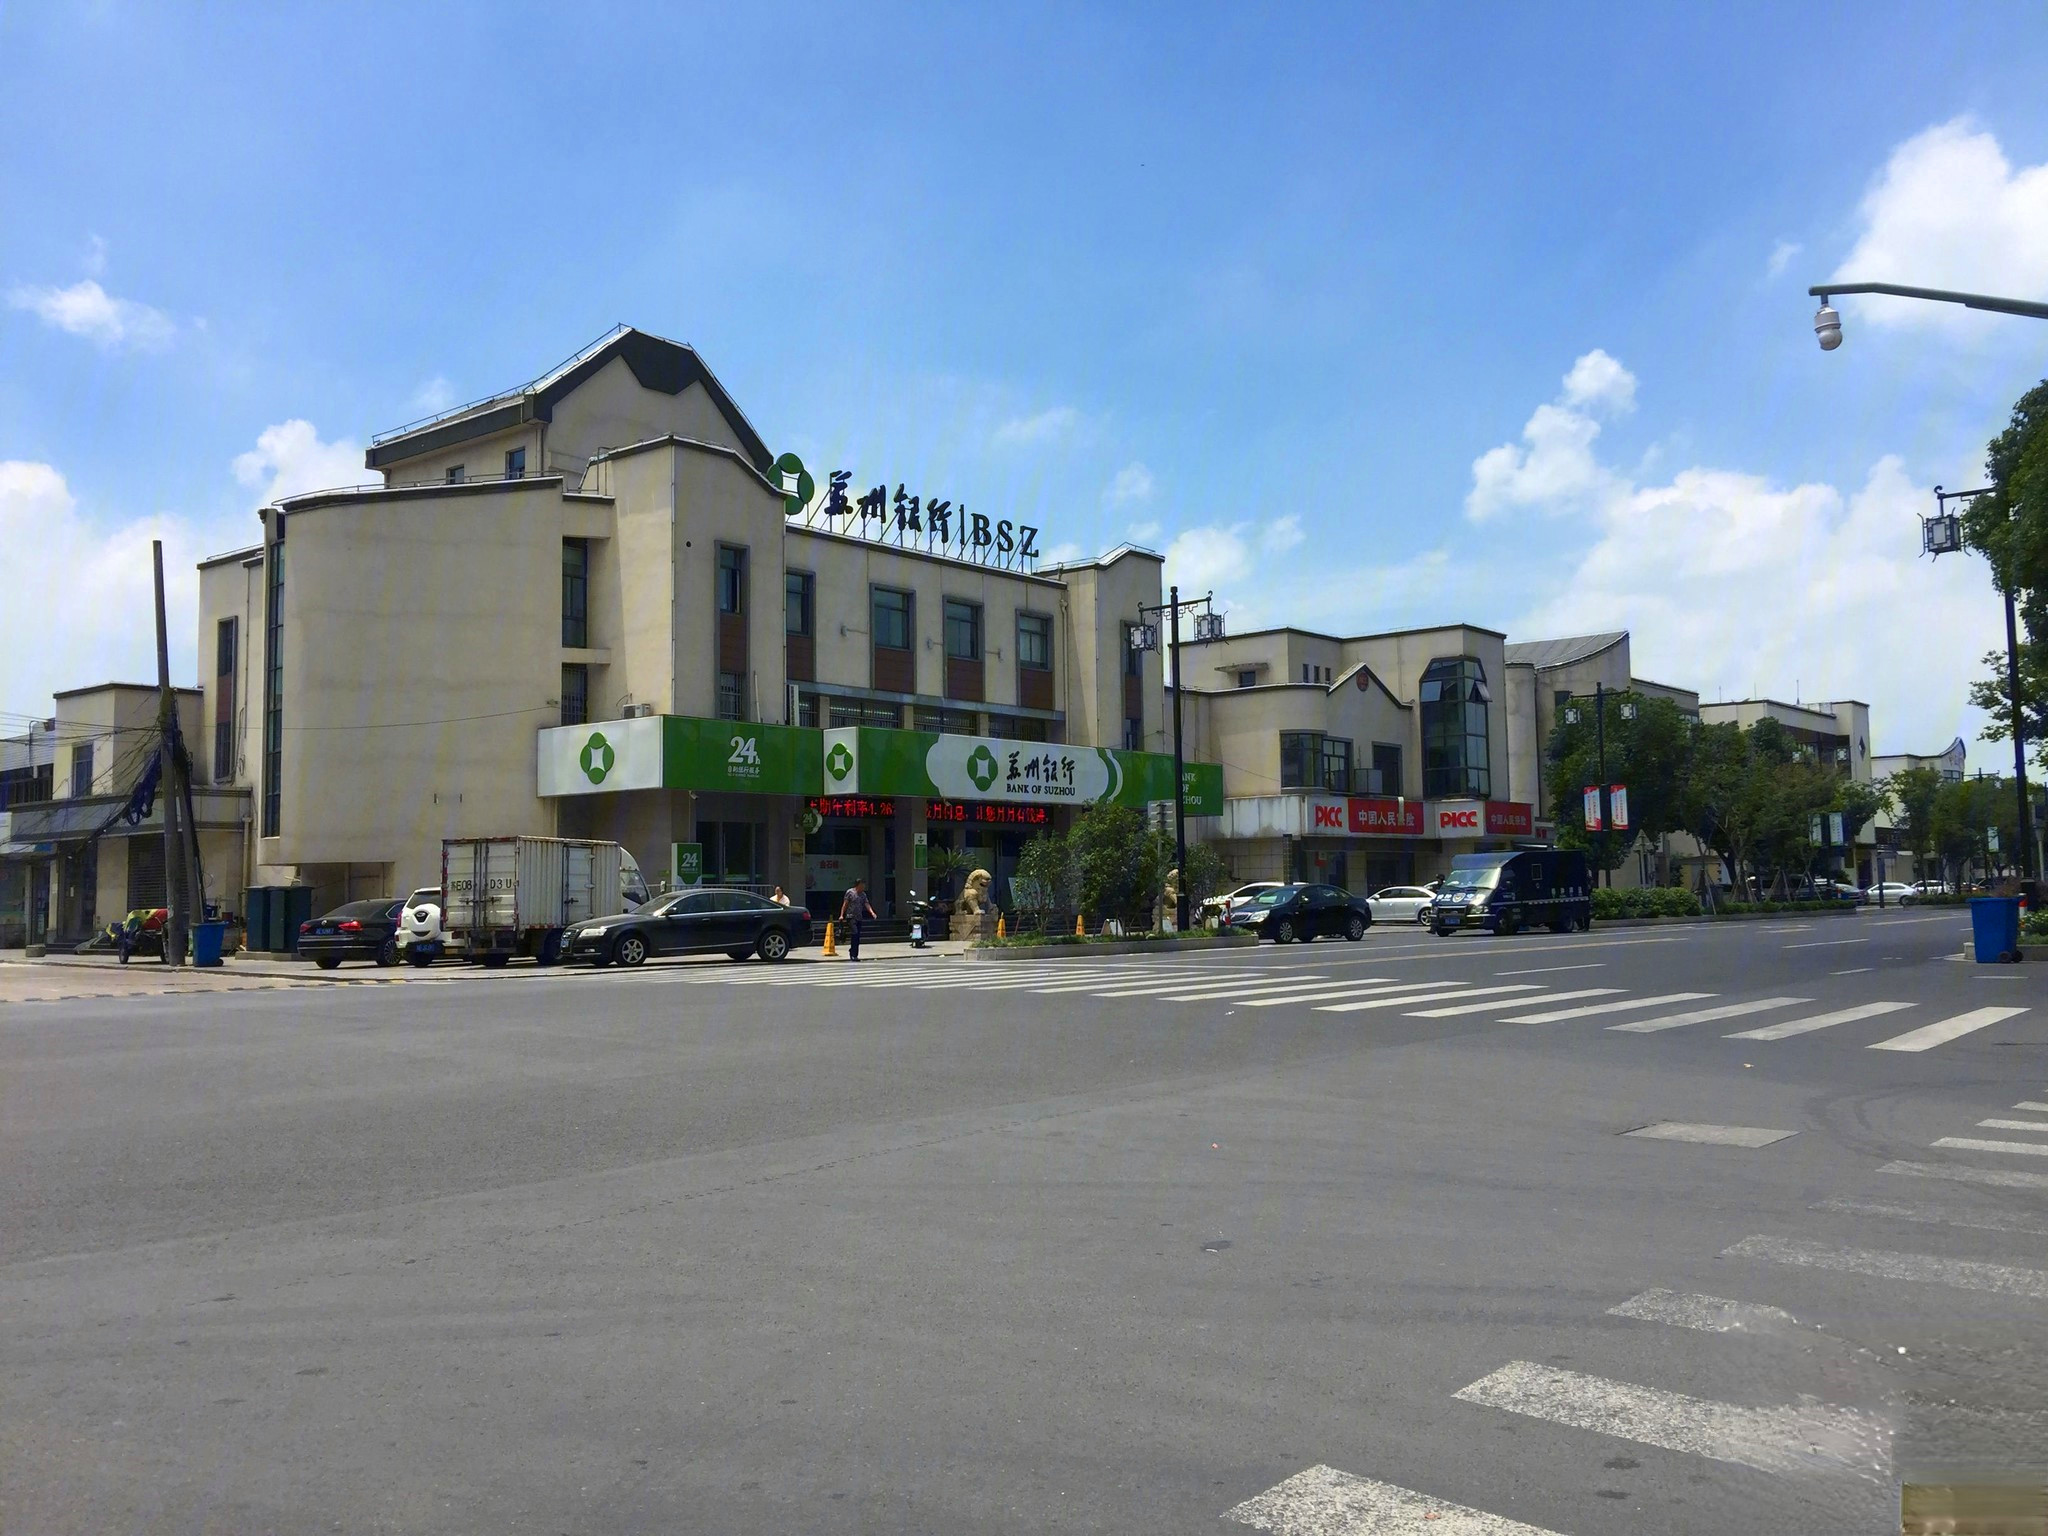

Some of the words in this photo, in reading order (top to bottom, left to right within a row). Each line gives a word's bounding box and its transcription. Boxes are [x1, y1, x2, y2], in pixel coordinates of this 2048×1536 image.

[824, 469, 952, 544] 苏州银行
[971, 513, 1039, 557] BSZ
[1006, 751, 1075, 785] 苏州银行
[1006, 783, 1030, 794] BANK
[1031, 784, 1042, 794] OF
[1044, 785, 1076, 796] SUZHOU
[1314, 805, 1343, 828] PICC
[1358, 809, 1415, 827] 中国人民险
[1440, 810, 1478, 828] PICC
[681, 852, 698, 867] 24
